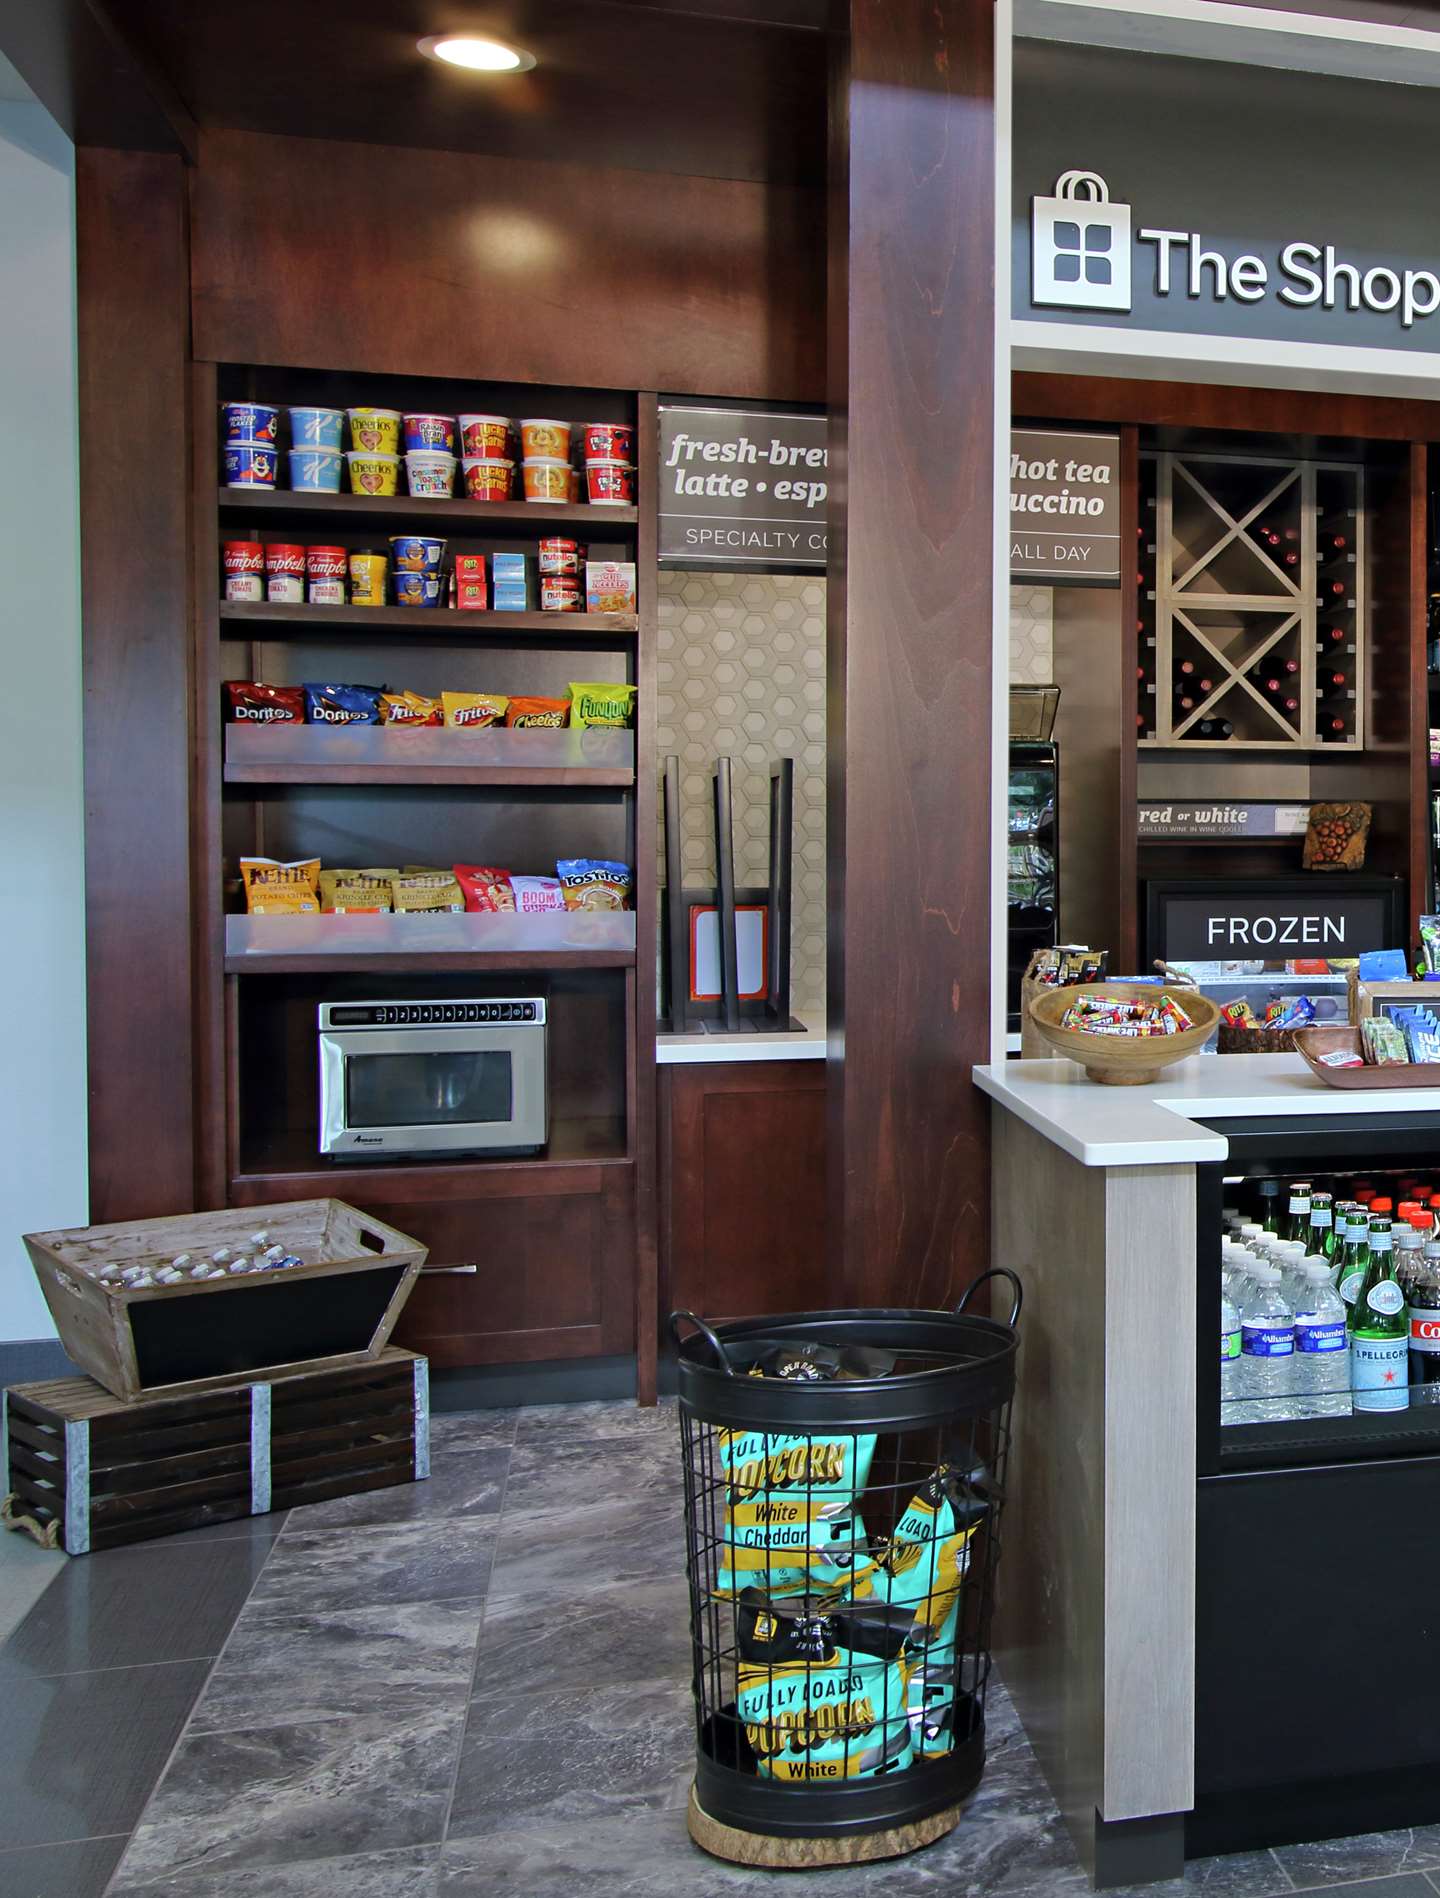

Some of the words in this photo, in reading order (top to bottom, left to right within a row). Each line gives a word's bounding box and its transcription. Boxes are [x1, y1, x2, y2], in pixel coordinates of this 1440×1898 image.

[1138, 228, 1268, 301] The
[351, 420, 391, 431] Cheerios
[351, 462, 392, 473] Cheerios
[1010, 454, 1059, 481] hot
[1065, 460, 1111, 484] tea
[674, 469, 749, 497] latte
[774, 481, 827, 508] esp
[1009, 489, 1104, 516] uccino
[686, 529, 800, 548] SPECIALTY
[543, 554, 573, 562] nutella
[1010, 544, 1046, 560] ALL
[1054, 545, 1091, 561] DAY
[235, 706, 293, 719] Doritos
[313, 707, 369, 721] Doritos
[455, 706, 498, 724] Fritos
[514, 711, 562, 728] Cheetos
[1139, 807, 1172, 823] red
[1178, 813, 1191, 821] or
[1194, 807, 1248, 823] white
[563, 870, 632, 888] TOSTITOS
[522, 891, 556, 903] BOOM
[1208, 916, 1346, 944] FROZEN
[1228, 1004, 1245, 1019] RITZ
[1270, 1004, 1286, 1018] RITZ
[1312, 1329, 1345, 1339] Alhambra
[727, 1434, 780, 1462] FULLY
[725, 1443, 846, 1500] POPCORN
[755, 1503, 798, 1523] White
[745, 1526, 807, 1548] Cheddar
[744, 1686, 798, 1716] FULLY
[803, 1675, 864, 1701] LOADED
[746, 1697, 876, 1753] POPCORN
[788, 1761, 838, 1778] White
